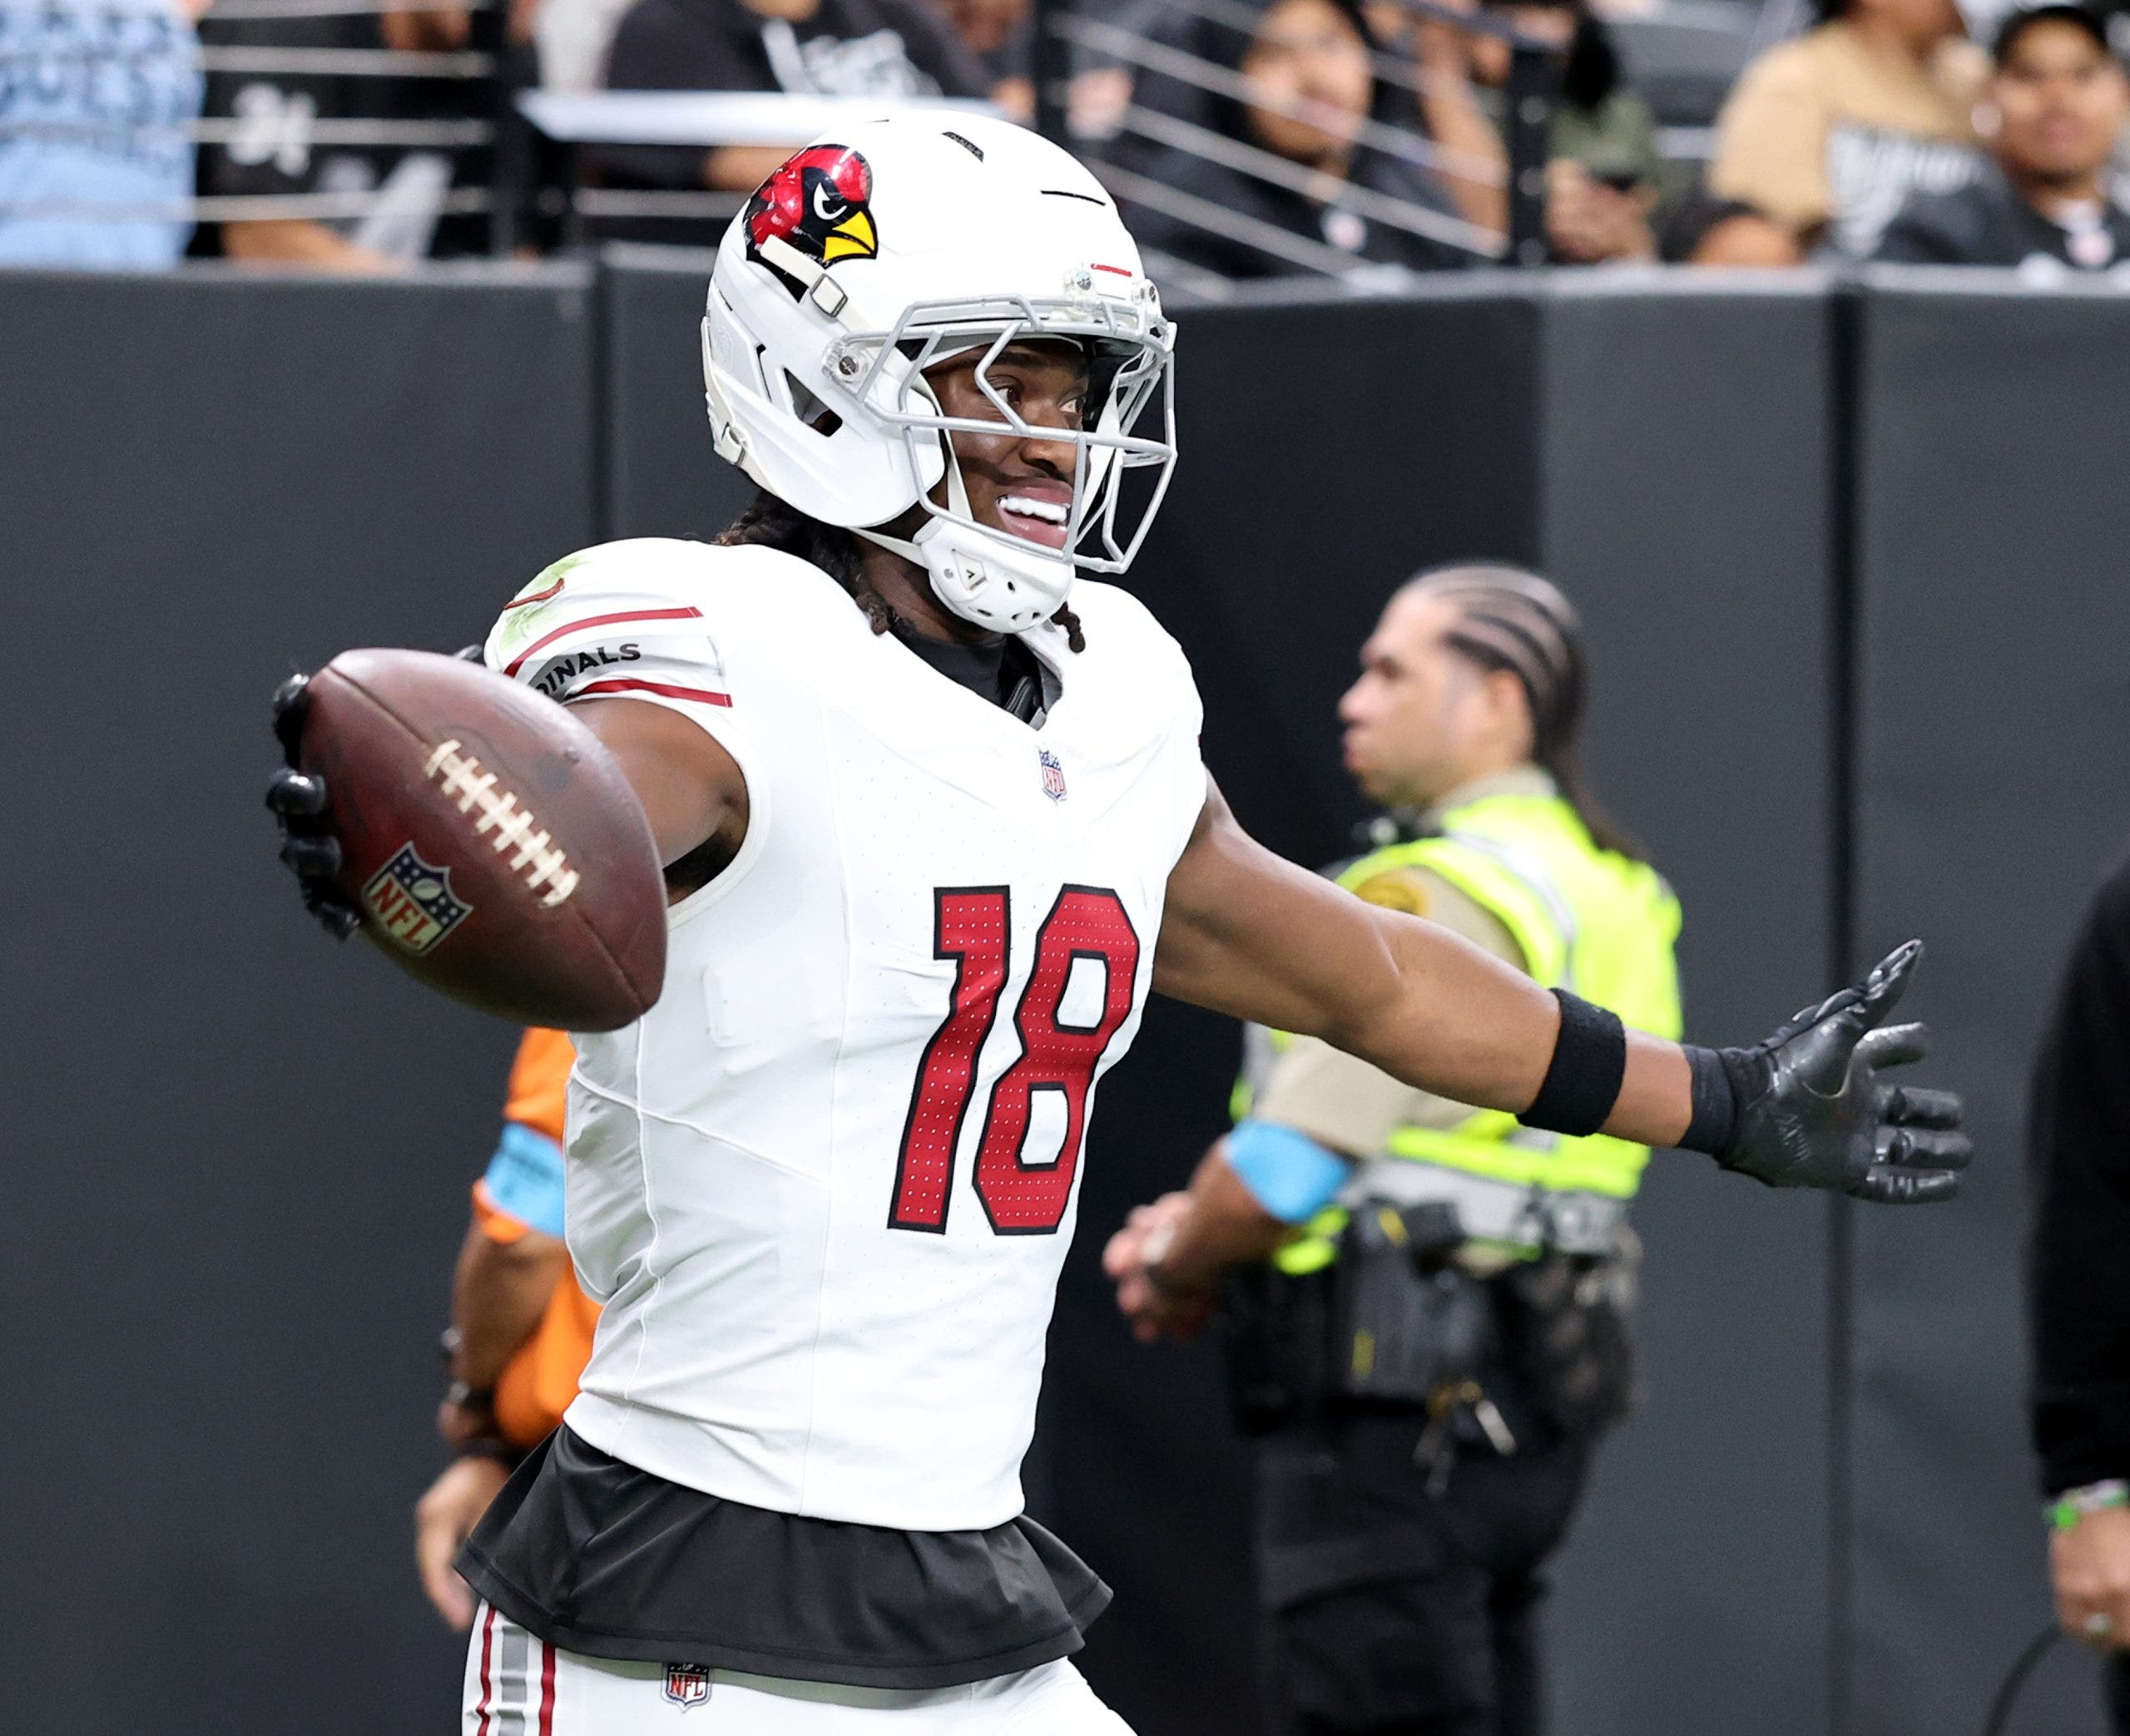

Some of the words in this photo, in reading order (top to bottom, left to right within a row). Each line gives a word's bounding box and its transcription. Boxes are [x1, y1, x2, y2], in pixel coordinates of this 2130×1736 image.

[371, 878, 431, 946] NFL
[888, 883, 1139, 1235] 18
[669, 1673, 704, 1699] NFL
